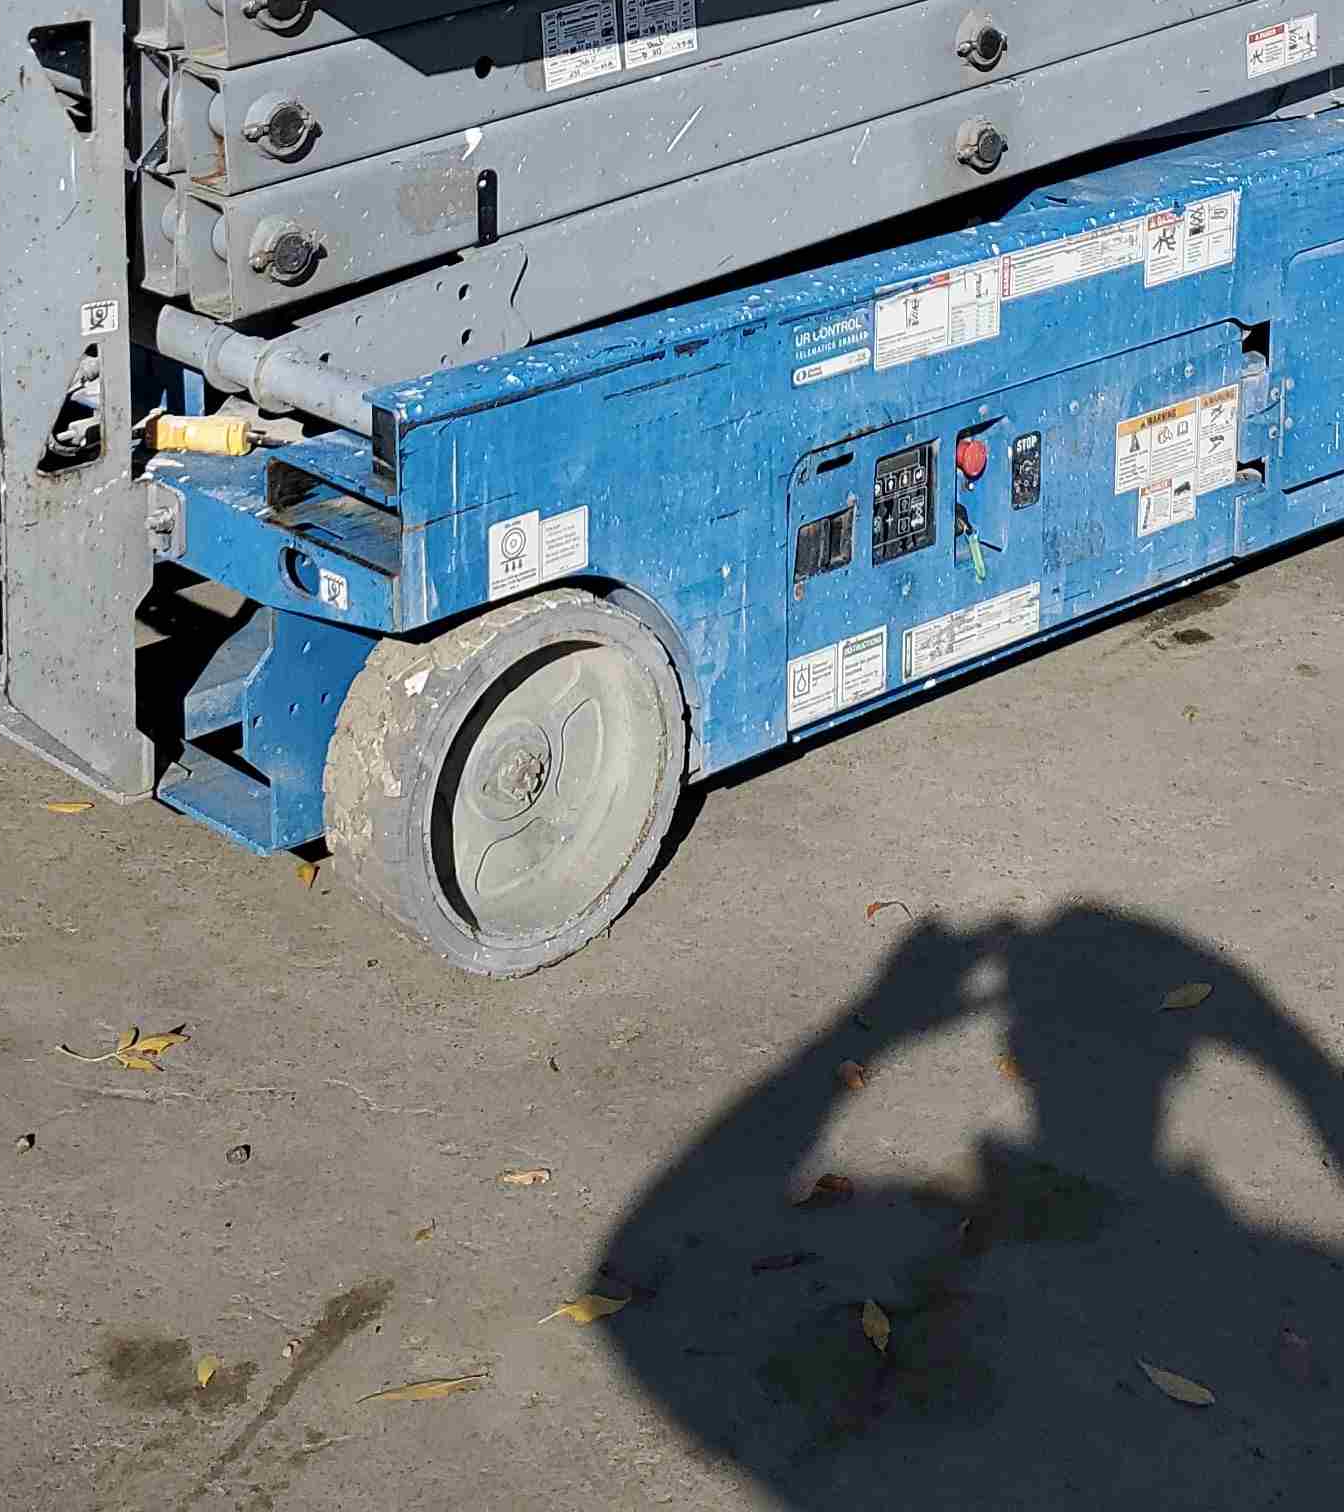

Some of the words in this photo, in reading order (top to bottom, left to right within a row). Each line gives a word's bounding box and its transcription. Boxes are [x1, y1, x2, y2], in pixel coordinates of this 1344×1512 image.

[795, 331, 811, 347] UR
[812, 316, 862, 343] CONTROL
[1016, 435, 1037, 452] STOP
